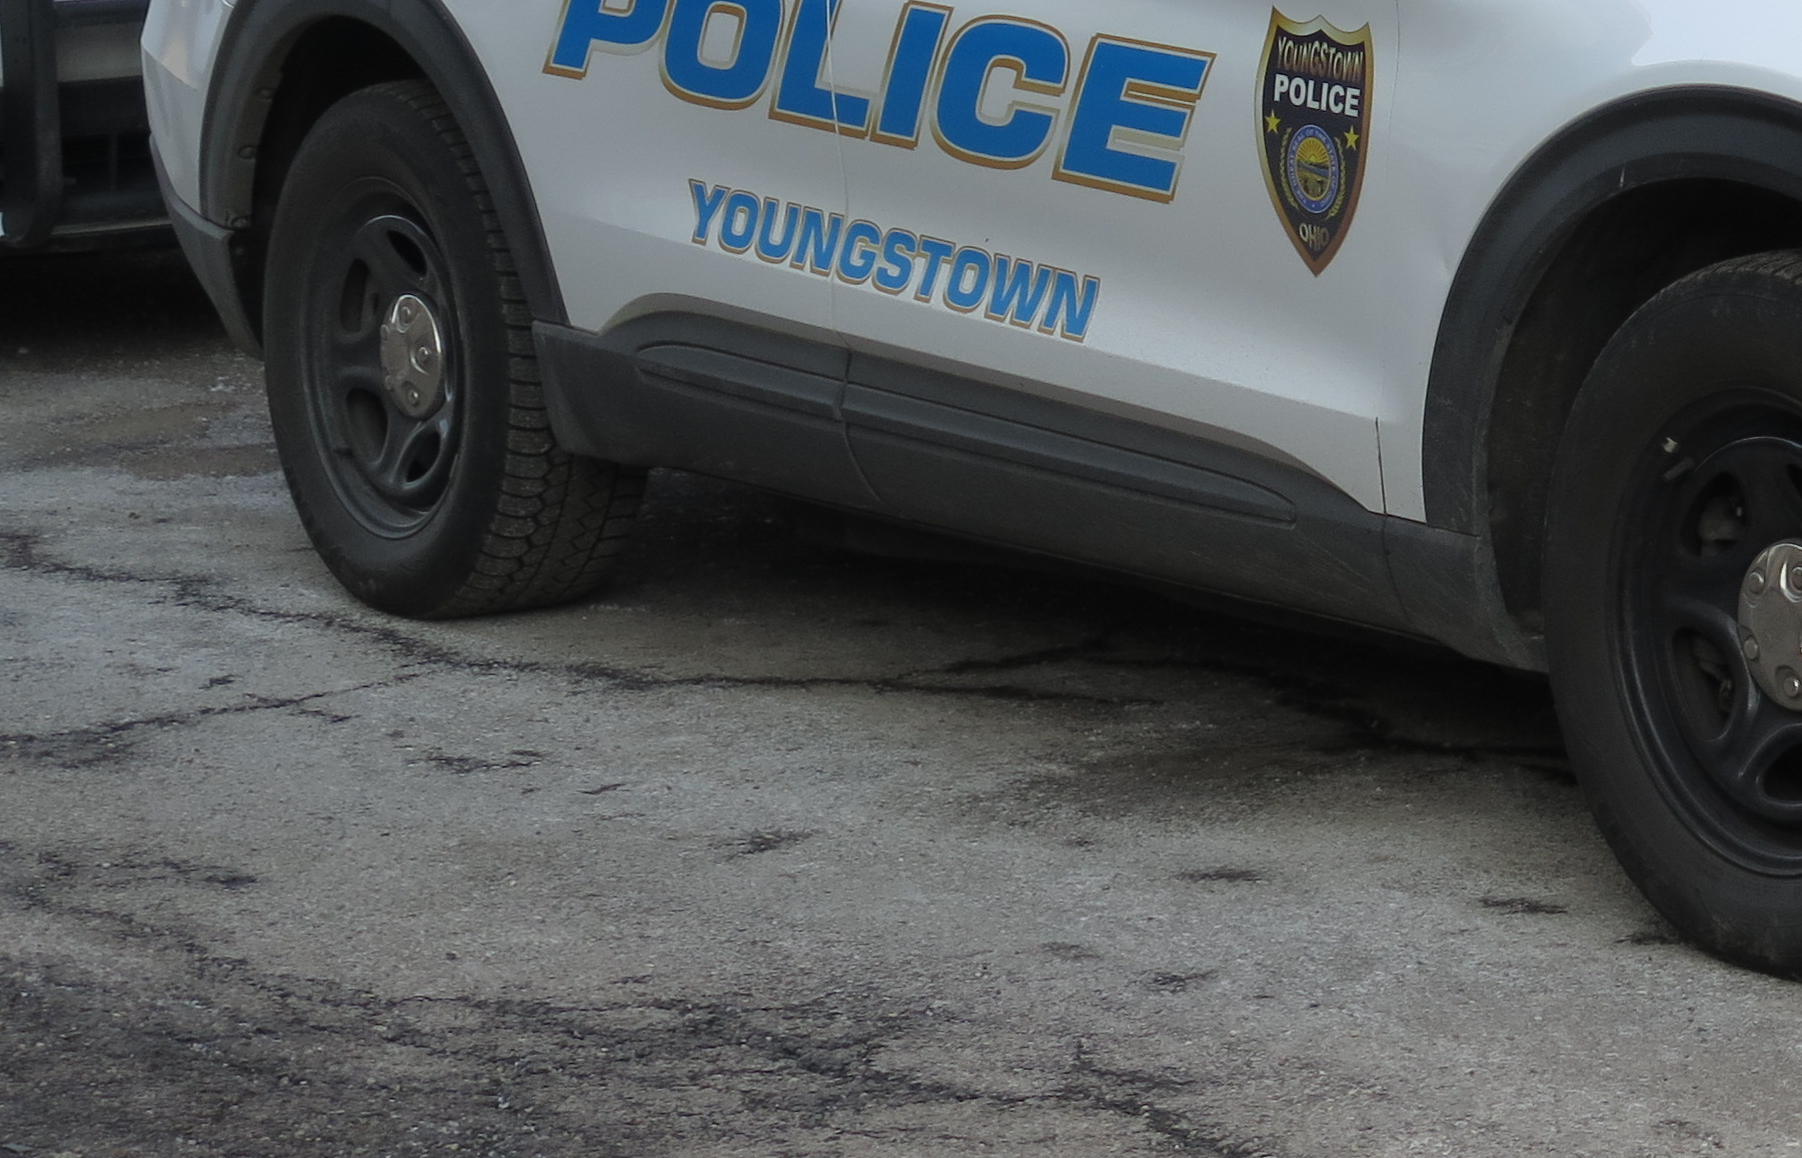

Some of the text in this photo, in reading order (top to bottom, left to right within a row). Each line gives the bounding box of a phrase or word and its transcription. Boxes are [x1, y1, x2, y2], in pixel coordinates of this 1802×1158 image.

[1277, 36, 1364, 82] YOUNGSTOWN
[1274, 73, 1361, 118] POLICE
[1299, 222, 1329, 251] OHIO
[688, 178, 1100, 343] YOUNGSTOWN
